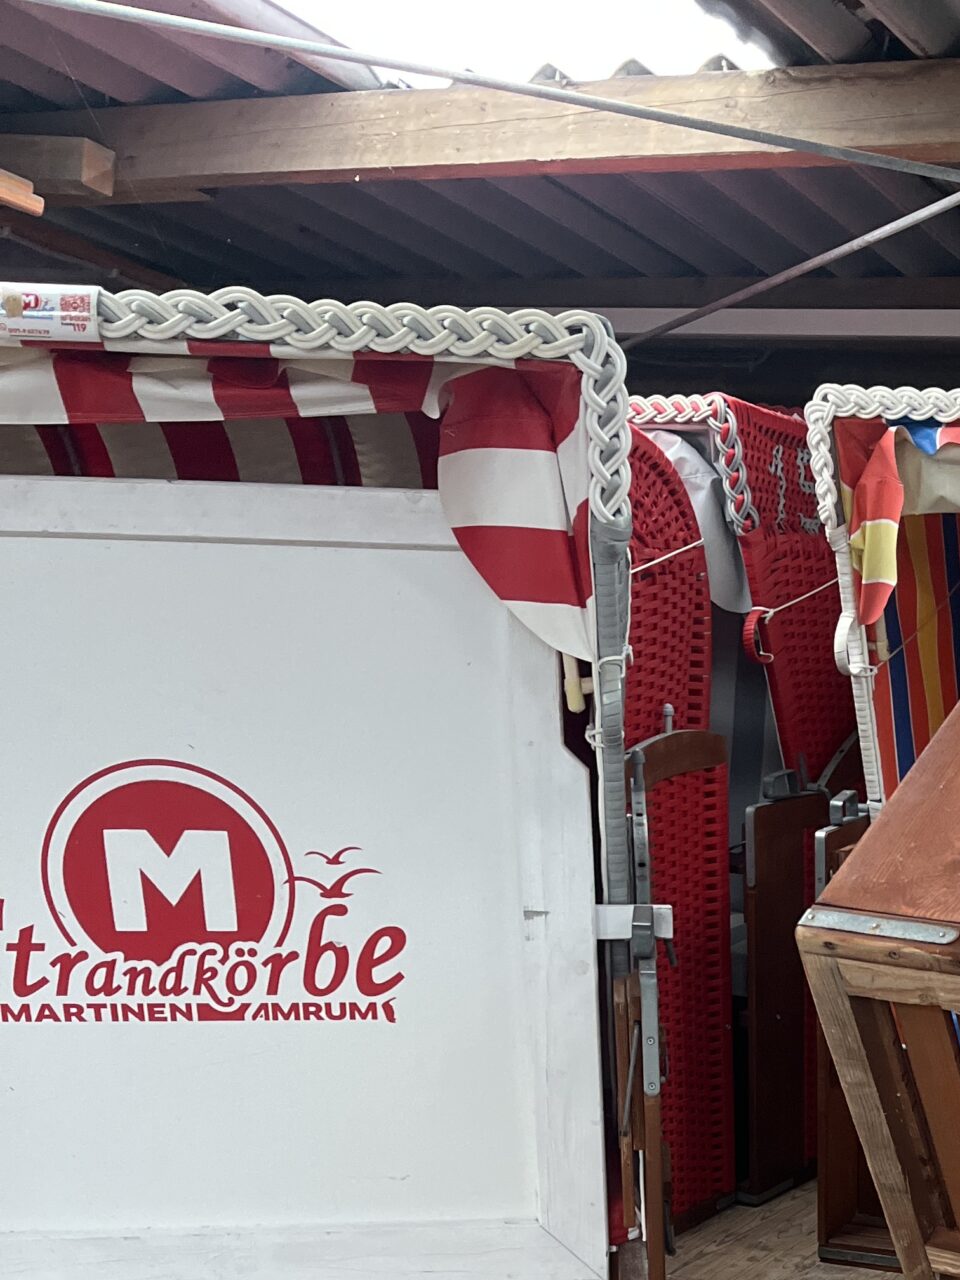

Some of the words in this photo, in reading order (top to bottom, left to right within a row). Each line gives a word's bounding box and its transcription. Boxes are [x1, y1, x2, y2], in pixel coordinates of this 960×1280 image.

[103, 829, 239, 933] M
[0, 899, 408, 1006] trandkörbe
[0, 1003, 193, 1022] MARTINEN
[252, 1002, 378, 1021] AMRUM
